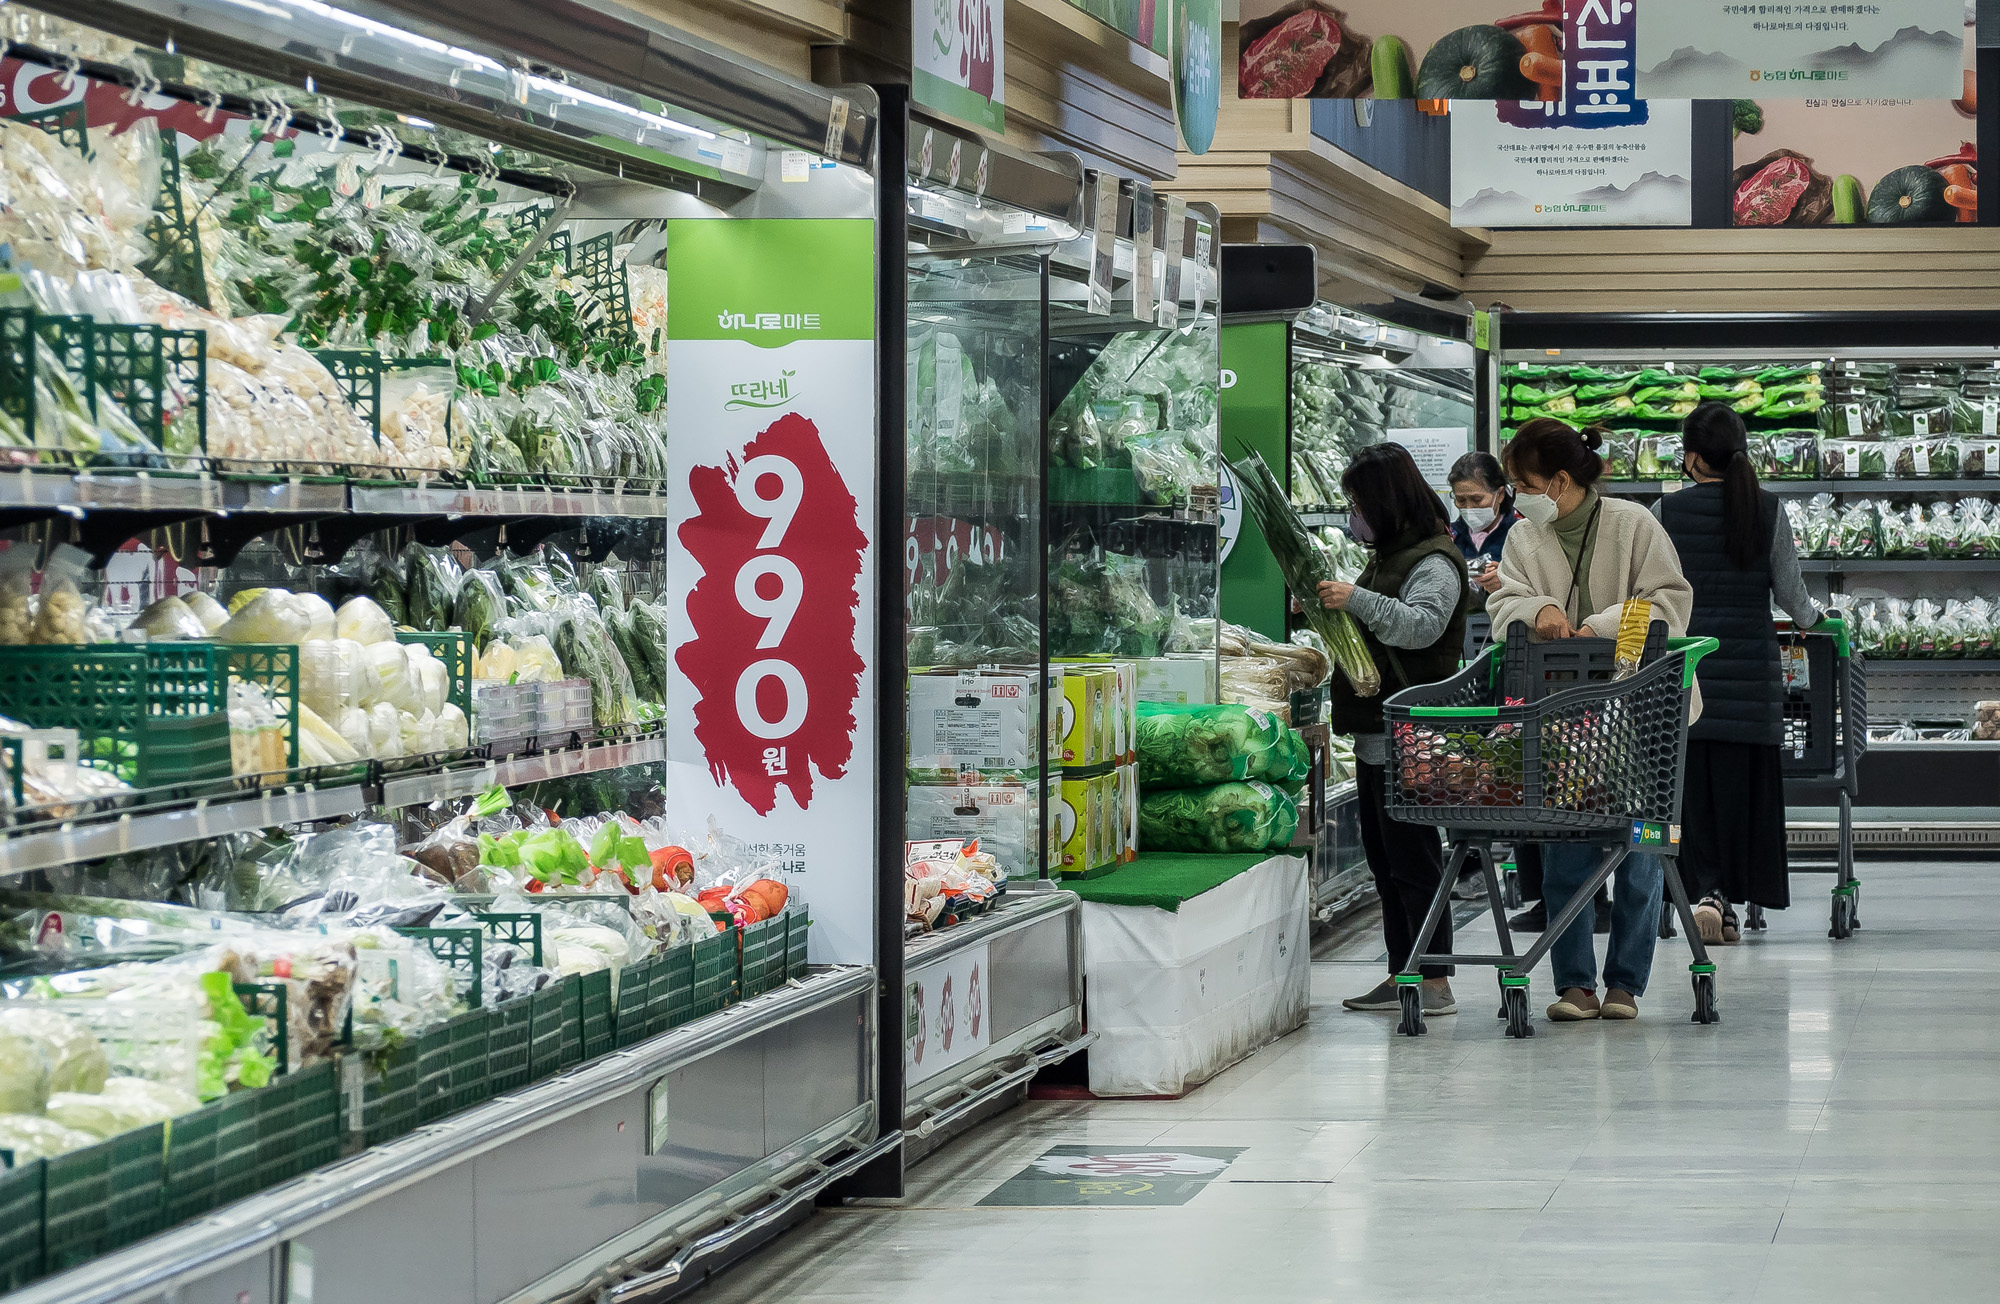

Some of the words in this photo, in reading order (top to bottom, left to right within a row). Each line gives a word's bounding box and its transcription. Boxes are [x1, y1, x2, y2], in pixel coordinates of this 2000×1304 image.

[1722, 4, 1756, 14] 국민에게
[1758, 4, 1792, 14] 합리적인
[1794, 4, 1828, 14] 가격으로
[1830, 4, 1881, 14] 판매하겠다는
[1752, 21, 1803, 31] 하나로마트의
[1805, 21, 1849, 31] 다짐입니다.
[1763, 70, 1787, 81] 농협
[1575, 143, 1594, 151] 우수한
[1513, 156, 1539, 164] 국민에게
[1540, 156, 1565, 164] 합리적인
[1536, 168, 1574, 176] 하나로마트의
[1574, 168, 1608, 176] 다짐입니다.
[1544, 204, 1562, 213] 농협
[717, 308, 821, 331] 하나로마트
[772, 842, 807, 857] 즐거움
